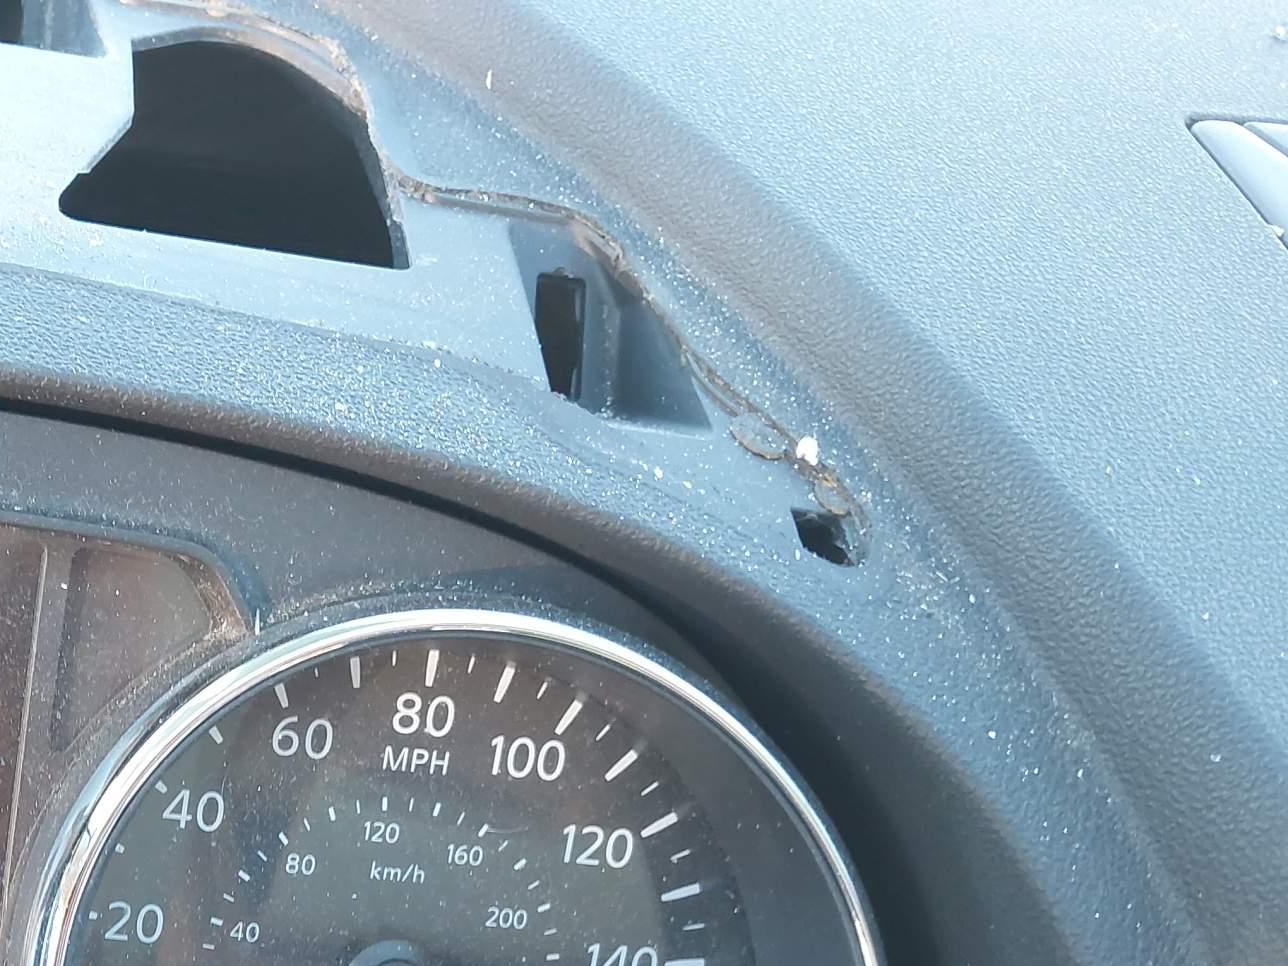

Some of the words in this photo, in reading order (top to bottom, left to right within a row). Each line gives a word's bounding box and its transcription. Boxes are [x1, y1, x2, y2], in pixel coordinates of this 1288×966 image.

[392, 692, 455, 738] 80
[272, 716, 334, 760] 60
[382, 745, 450, 776] MPH
[490, 735, 565, 782] 100
[162, 789, 225, 832] 40
[363, 821, 400, 844] 120
[563, 824, 634, 869] 120
[285, 854, 316, 876] 80
[447, 843, 483, 866] 160
[369, 861, 425, 884] km/h
[104, 901, 164, 944] 20
[230, 921, 260, 943] 40
[485, 906, 527, 930] 200
